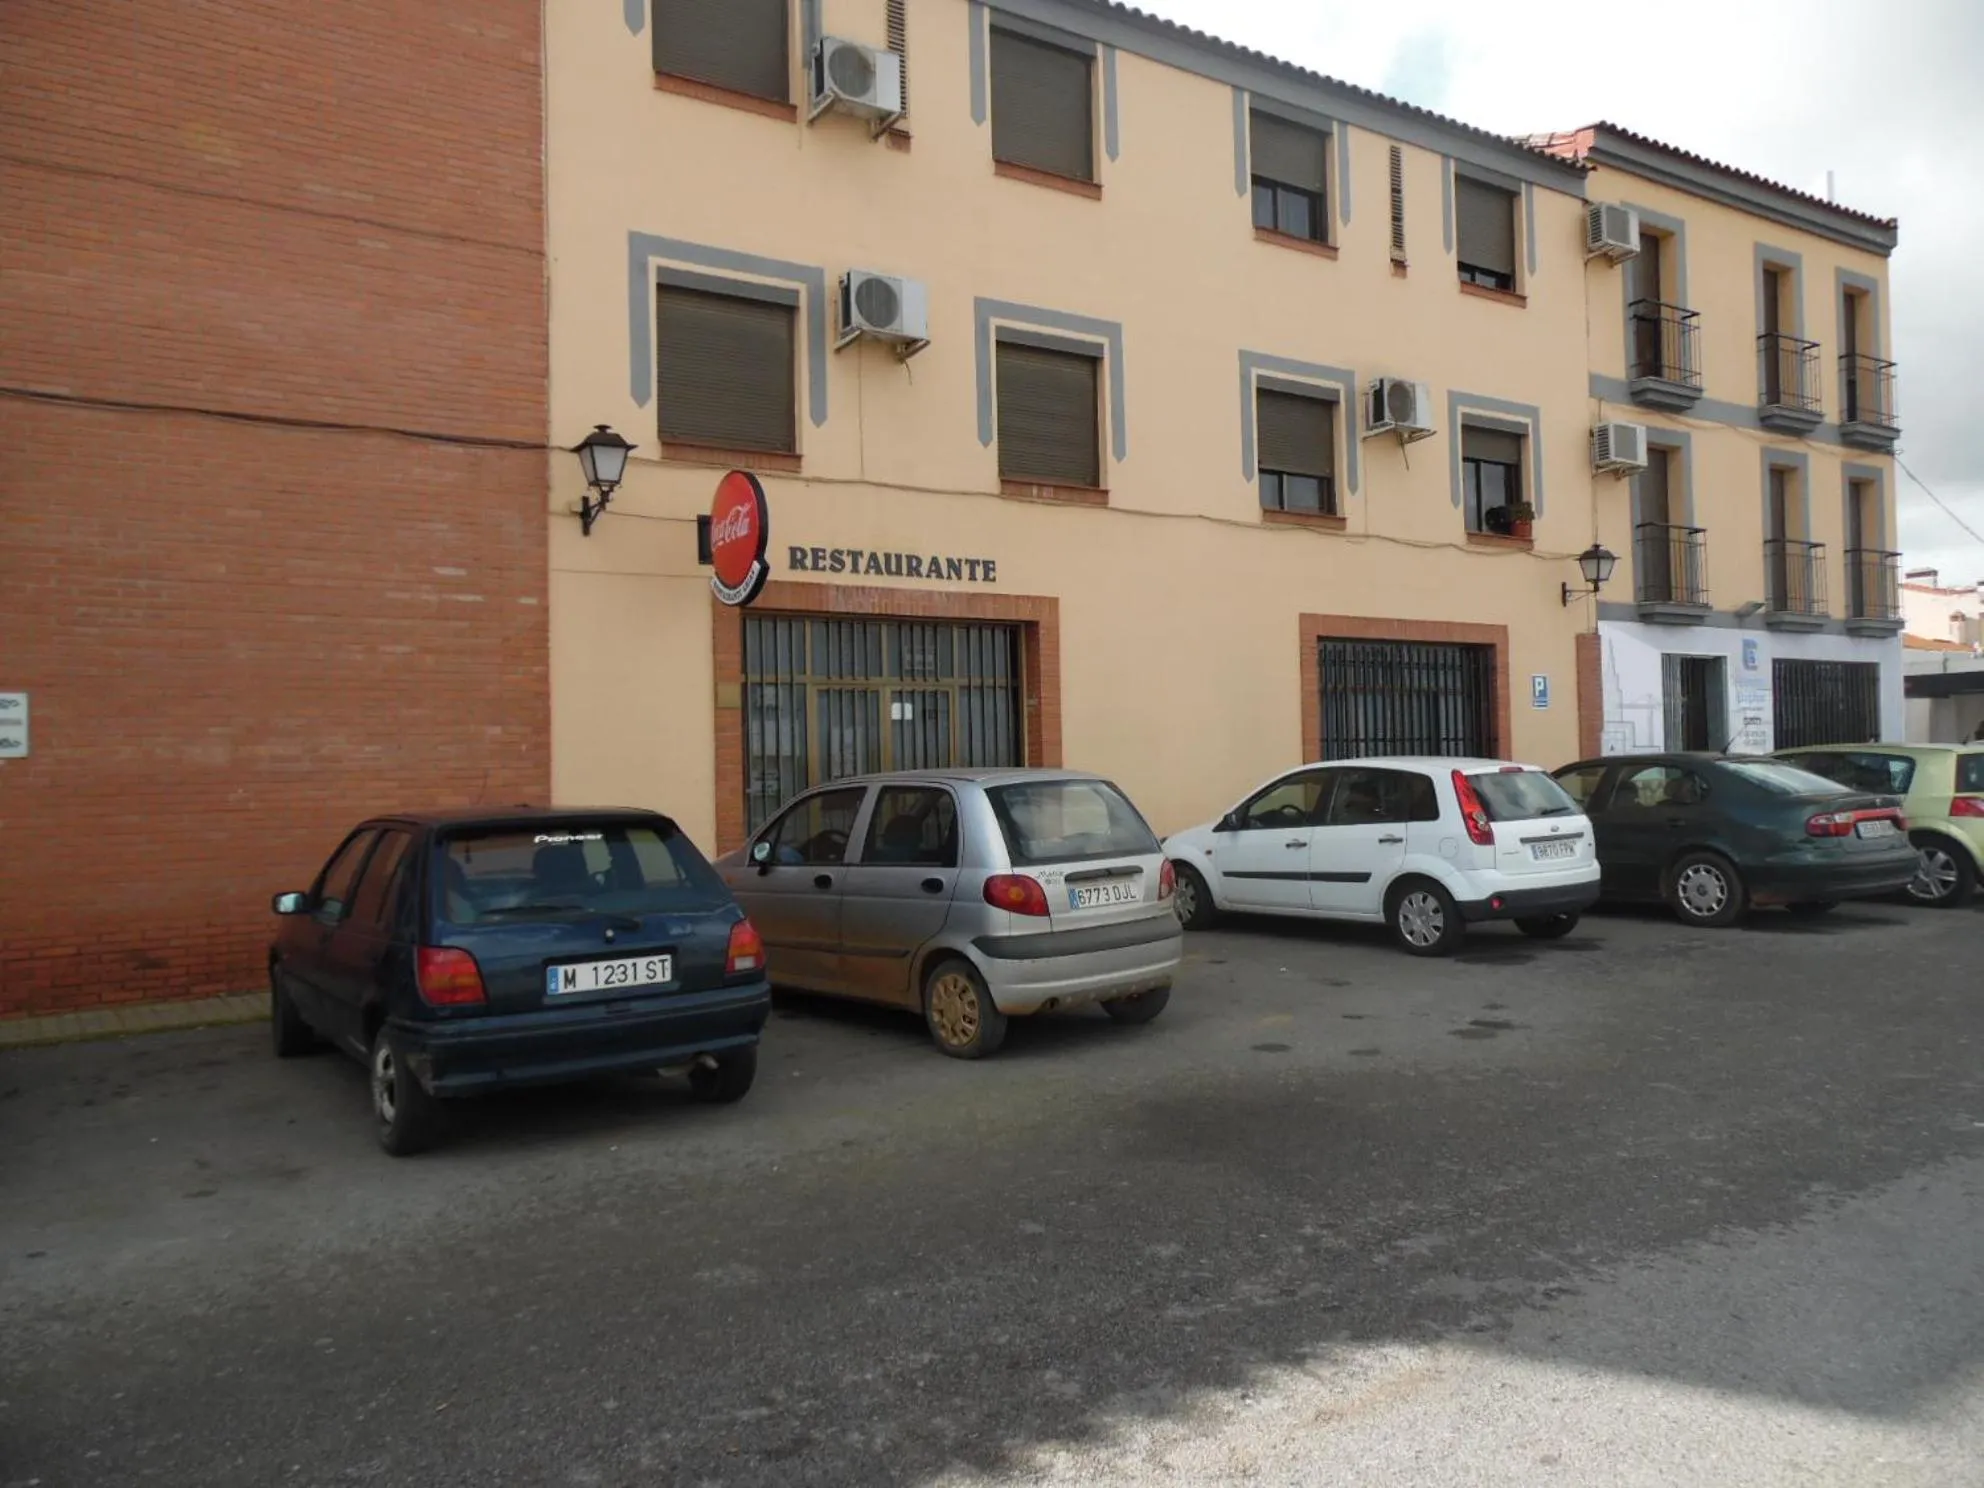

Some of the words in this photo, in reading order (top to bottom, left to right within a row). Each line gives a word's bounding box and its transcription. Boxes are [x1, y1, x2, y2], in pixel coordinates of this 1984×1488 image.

[788, 546, 996, 582] RESTAURANTE
[1535, 677, 1545, 697] P
[1078, 887, 1111, 905] 6773
[1113, 882, 1137, 900] DJL
[563, 968, 577, 990] M
[592, 961, 638, 987] 1231
[646, 958, 669, 981] ST
